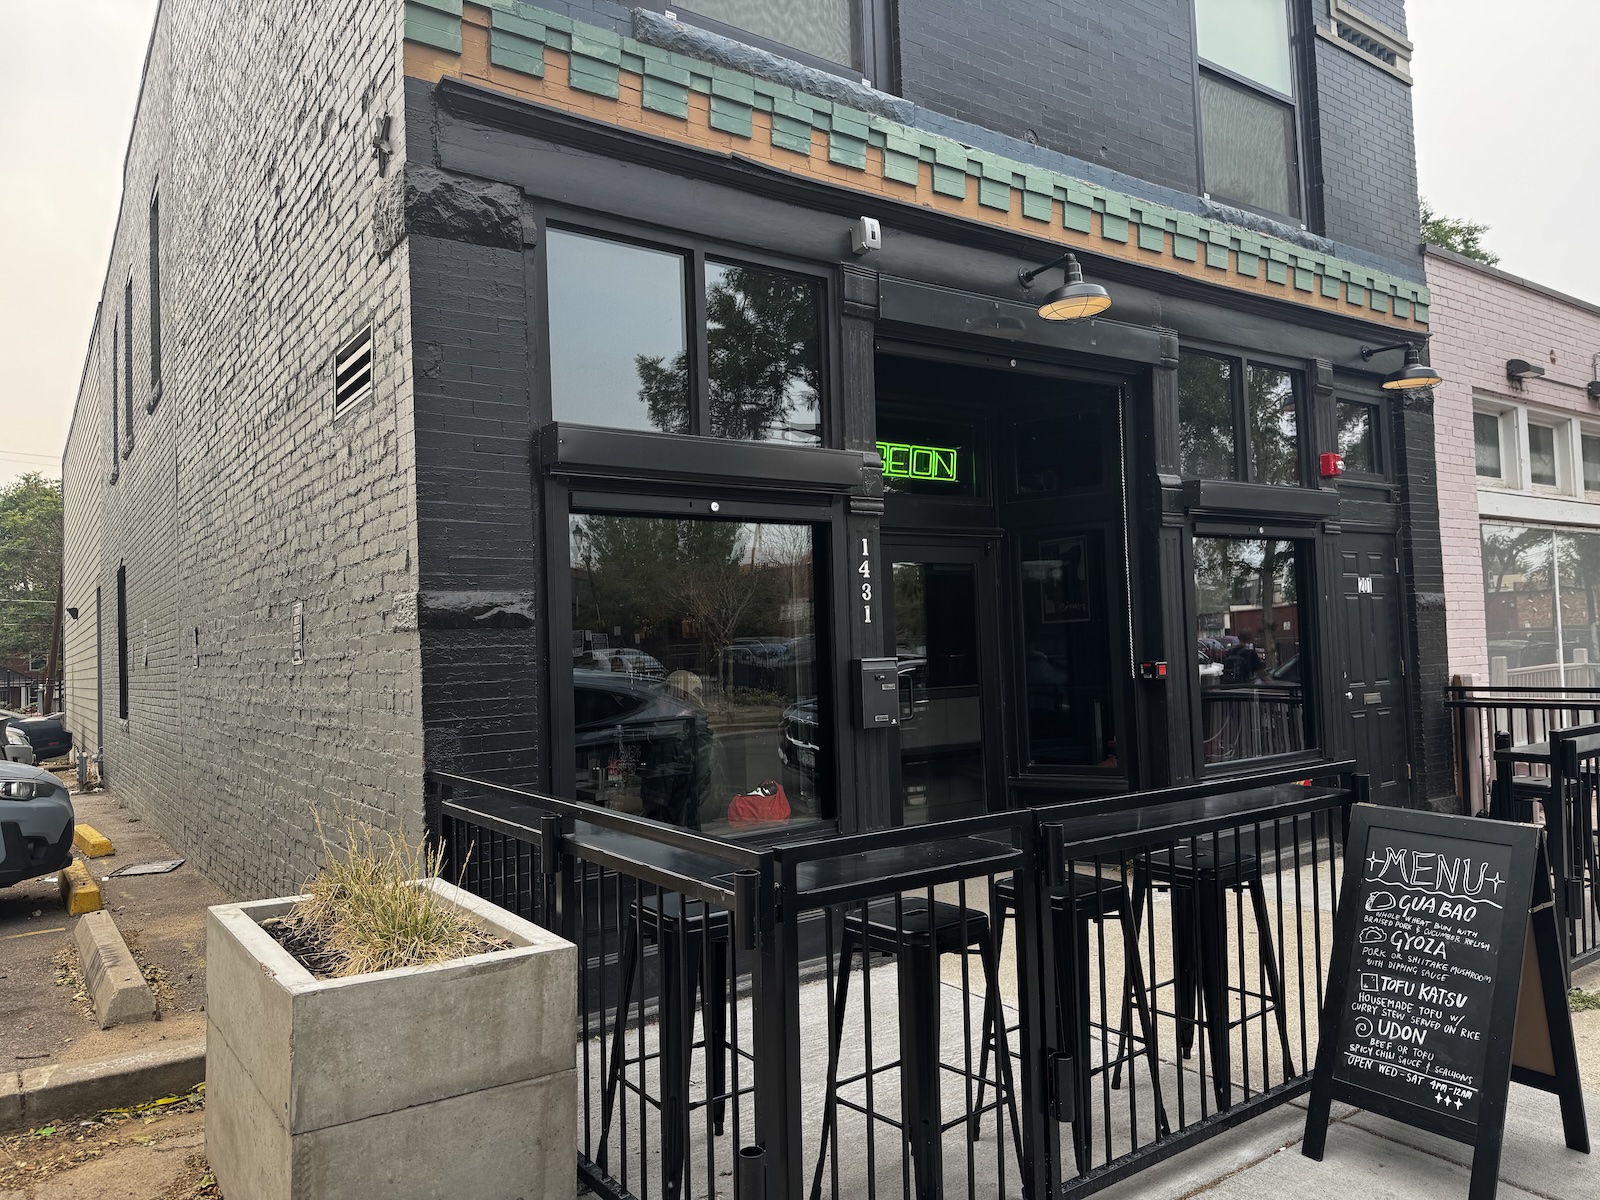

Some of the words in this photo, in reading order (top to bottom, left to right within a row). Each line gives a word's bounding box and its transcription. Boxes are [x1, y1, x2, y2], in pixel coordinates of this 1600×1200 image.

[858, 538, 872, 624] 1431
[1378, 847, 1489, 895] MENU
[1399, 894, 1436, 918] GUA
[1438, 901, 1477, 922] BAO
[1363, 914, 1394, 927] BRAISED
[1394, 920, 1413, 931] PORK
[1423, 928, 1461, 943] CUCUMBER
[1464, 937, 1491, 951] RELISH
[1375, 911, 1401, 921] WHOLE
[1405, 916, 1432, 927] WHEAT
[1433, 922, 1452, 932] BUN
[1456, 928, 1479, 938] WITH
[1390, 930, 1447, 960] GYOZA
[1361, 946, 1387, 958] PORK
[1390, 952, 1403, 960] OR
[1407, 955, 1449, 971] SHIITAKE
[1450, 966, 1492, 983] MUSHROOM
[1366, 958, 1384, 968] WITH
[1388, 961, 1418, 975] DIPPING
[1421, 969, 1450, 982] SAUCE
[1358, 991, 1414, 1014] HOUSEMADE
[1419, 1006, 1443, 1019] TOFU
[1380, 975, 1415, 996] TOFU
[1418, 982, 1468, 1008] KATSU
[1351, 1002, 1379, 1015] CURRY
[1381, 1007, 1406, 1020] STEW
[1410, 1015, 1442, 1030] SERVED
[1443, 1024, 1457, 1034] ON
[1460, 1027, 1481, 1041] RICE
[1377, 1018, 1428, 1046] UDON
[1347, 1055, 1374, 1070] OPEN
[1349, 1043, 1374, 1056] SPICY
[1375, 1049, 1396, 1060] CHILI
[1398, 1055, 1423, 1068] SAUCE
[1434, 1065, 1474, 1085] SCALLIONS
[1370, 1037, 1393, 1050] BEEF
[1397, 1045, 1409, 1055] OR
[1412, 1047, 1435, 1061] TOFU
